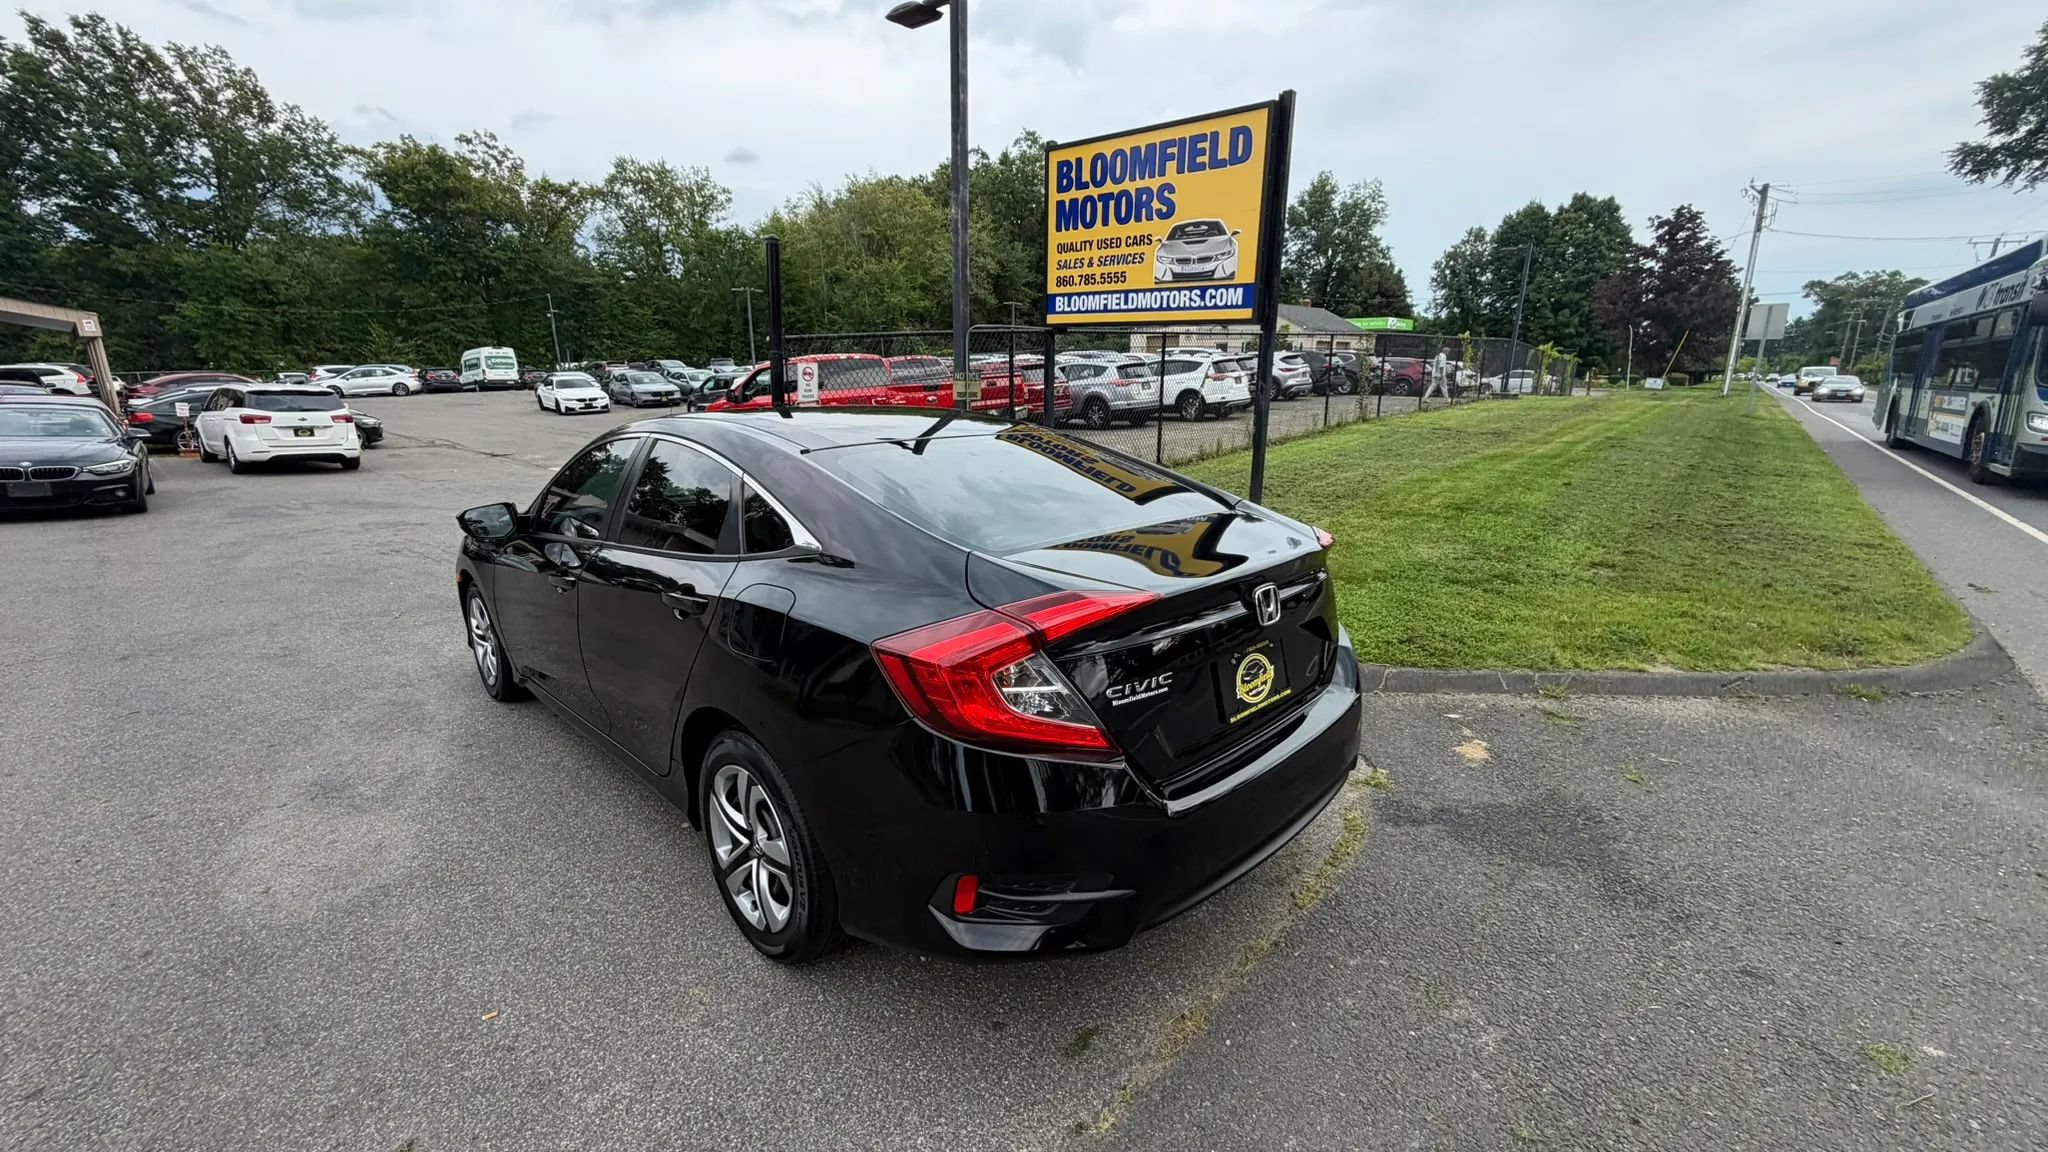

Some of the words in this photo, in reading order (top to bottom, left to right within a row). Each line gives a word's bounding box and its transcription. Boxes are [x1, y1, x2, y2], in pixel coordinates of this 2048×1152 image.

[1056, 125, 1253, 194] BLOOMFIELD
[1055, 183, 1176, 232] MOTORS
[1056, 239, 1094, 254] QUALITY
[1096, 236, 1122, 250] USED
[1125, 234, 1153, 248] CARS
[1056, 257, 1085, 271] SALES
[1087, 256, 1094, 268] &
[1097, 252, 1145, 268] SERVICES
[1055, 271, 1127, 288] 860.785.5555
[1055, 287, 1243, 312] BLOOMFIELDMOTORS.COM
[1106, 671, 1173, 699] CIVIC
